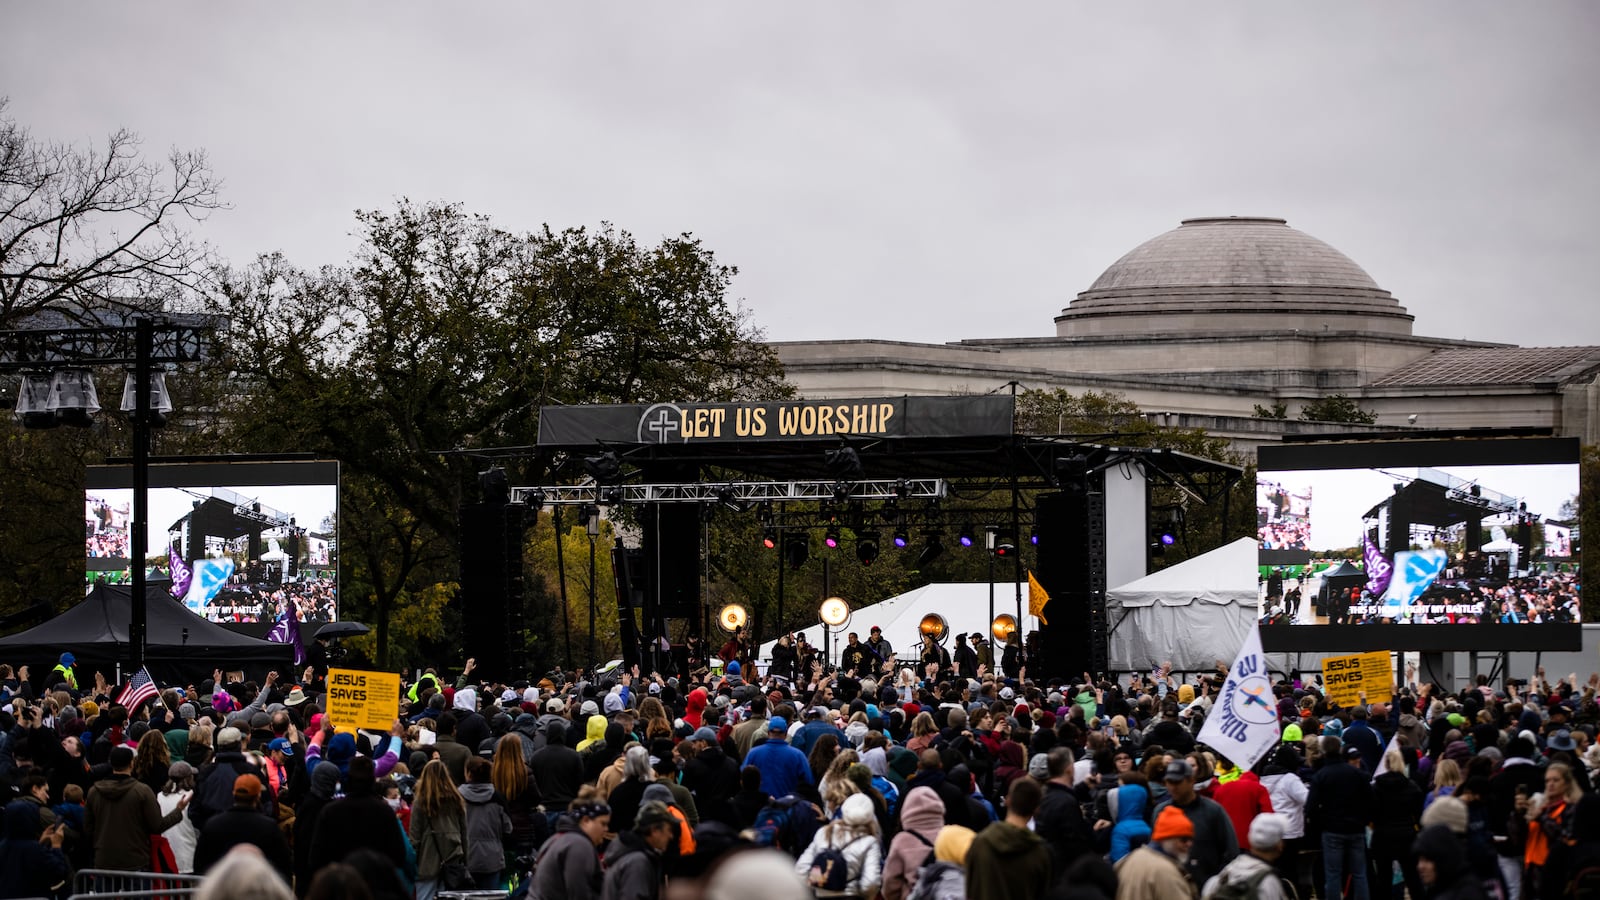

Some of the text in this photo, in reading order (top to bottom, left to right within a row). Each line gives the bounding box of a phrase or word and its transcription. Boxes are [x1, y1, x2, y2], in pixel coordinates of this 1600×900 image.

[681, 403, 894, 438] LET US WORSHIP
[221, 606, 232, 614] MY
[233, 606, 261, 614] BATTLES
[1348, 605, 1367, 614] THIS
[1368, 605, 1377, 614] IS
[1405, 605, 1430, 614] FIGHT
[1431, 605, 1445, 614] MY
[1446, 605, 1483, 614] BATTLES
[1325, 658, 1360, 672] JESUS
[331, 674, 367, 687] JESUS
[1326, 671, 1363, 685] SAVES
[330, 688, 367, 701] SAVES
